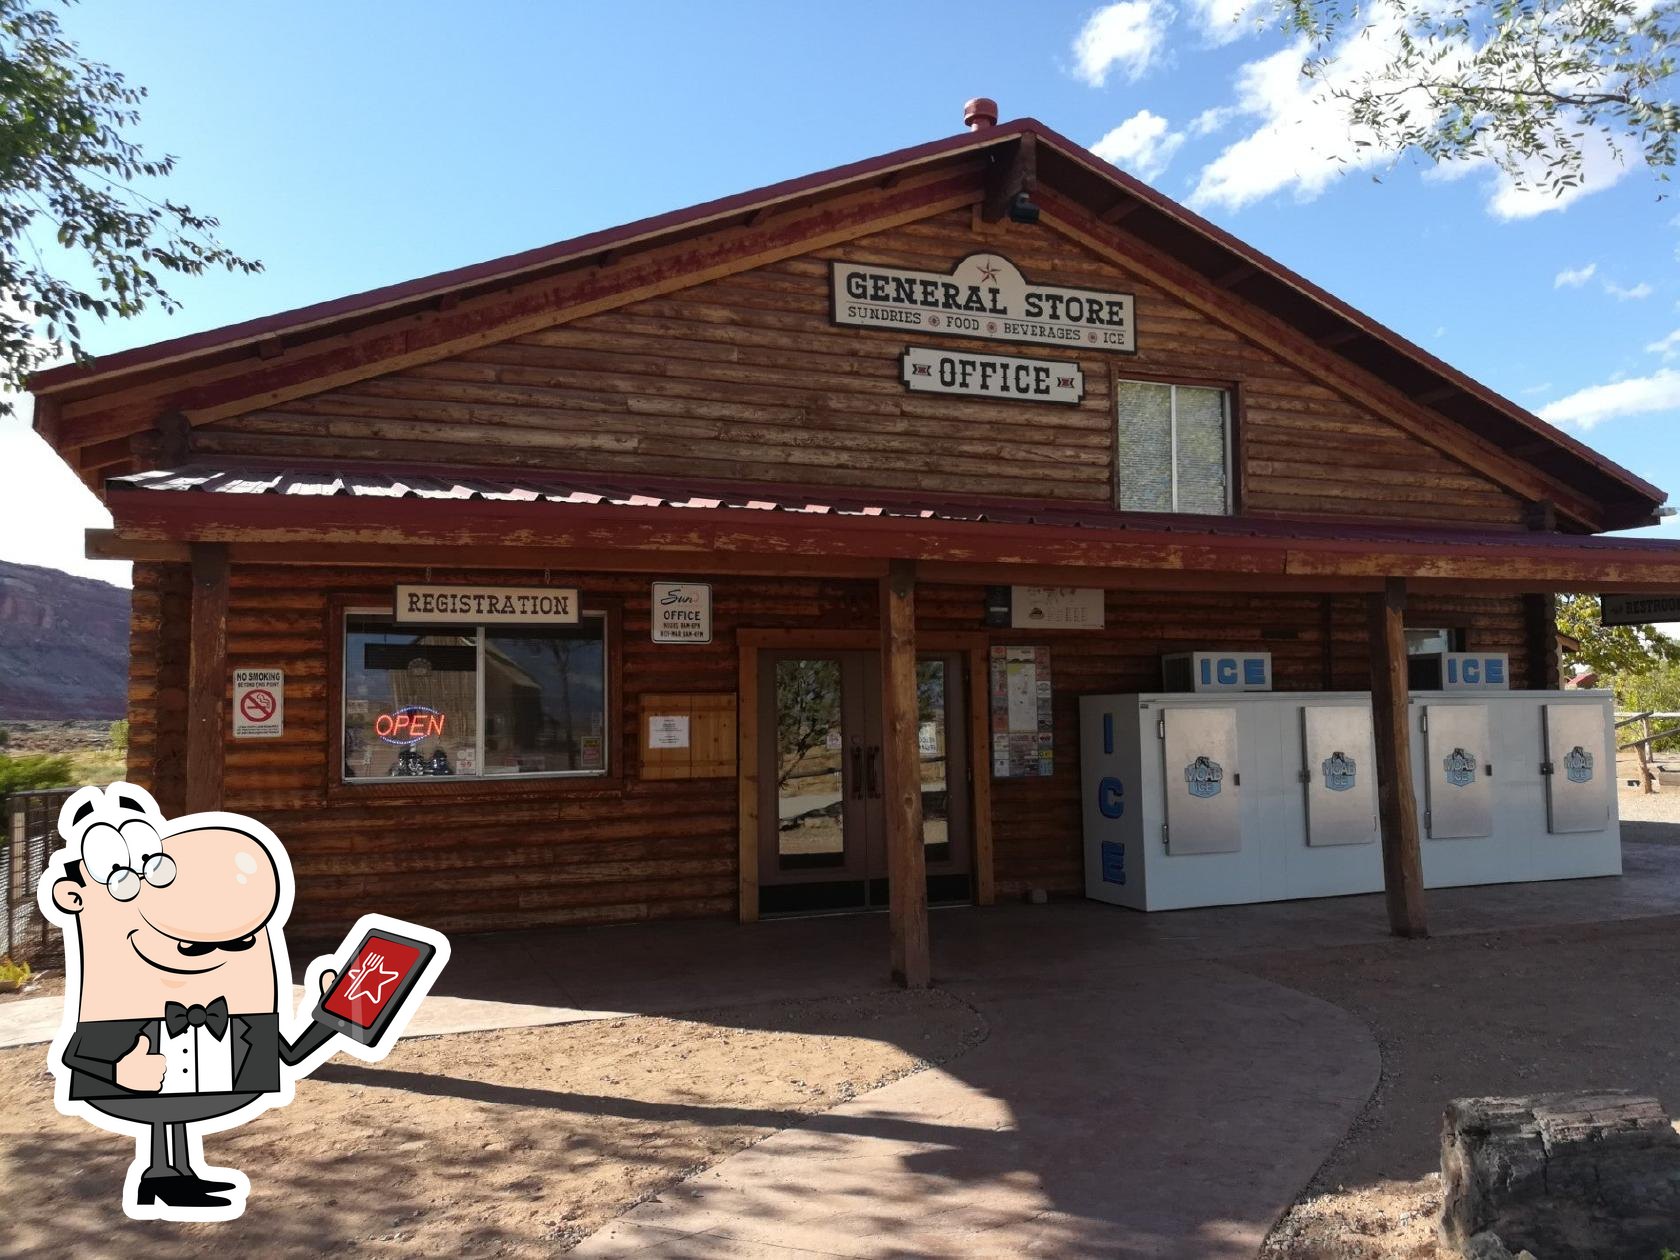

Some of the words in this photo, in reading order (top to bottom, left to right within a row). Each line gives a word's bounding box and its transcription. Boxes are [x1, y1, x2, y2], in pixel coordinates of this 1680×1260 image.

[846, 271, 1008, 316] GENERAL
[1024, 292, 1124, 327] STORE
[847, 306, 921, 325] SUNDRIES
[946, 316, 980, 331] FOOD
[1003, 322, 1081, 341] BEVERAGES
[1103, 332, 1125, 345] ICE
[938, 357, 1050, 395] OFFICE
[407, 592, 569, 616] REGISTRATION
[663, 610, 701, 620] OFFICE
[236, 672, 247, 682] NO
[248, 671, 281, 681] SMOKING
[1201, 658, 1266, 685] ICE
[1447, 658, 1504, 684] ICE
[376, 714, 445, 737] OPEN
[1322, 761, 1356, 776] MOAB
[1443, 757, 1477, 771] MOAB
[1564, 755, 1594, 769] MOAB
[1185, 766, 1223, 783] MOAB
[1333, 775, 1349, 785] ICE
[1195, 781, 1213, 792] ICE
[1098, 712, 1126, 886] ICE
